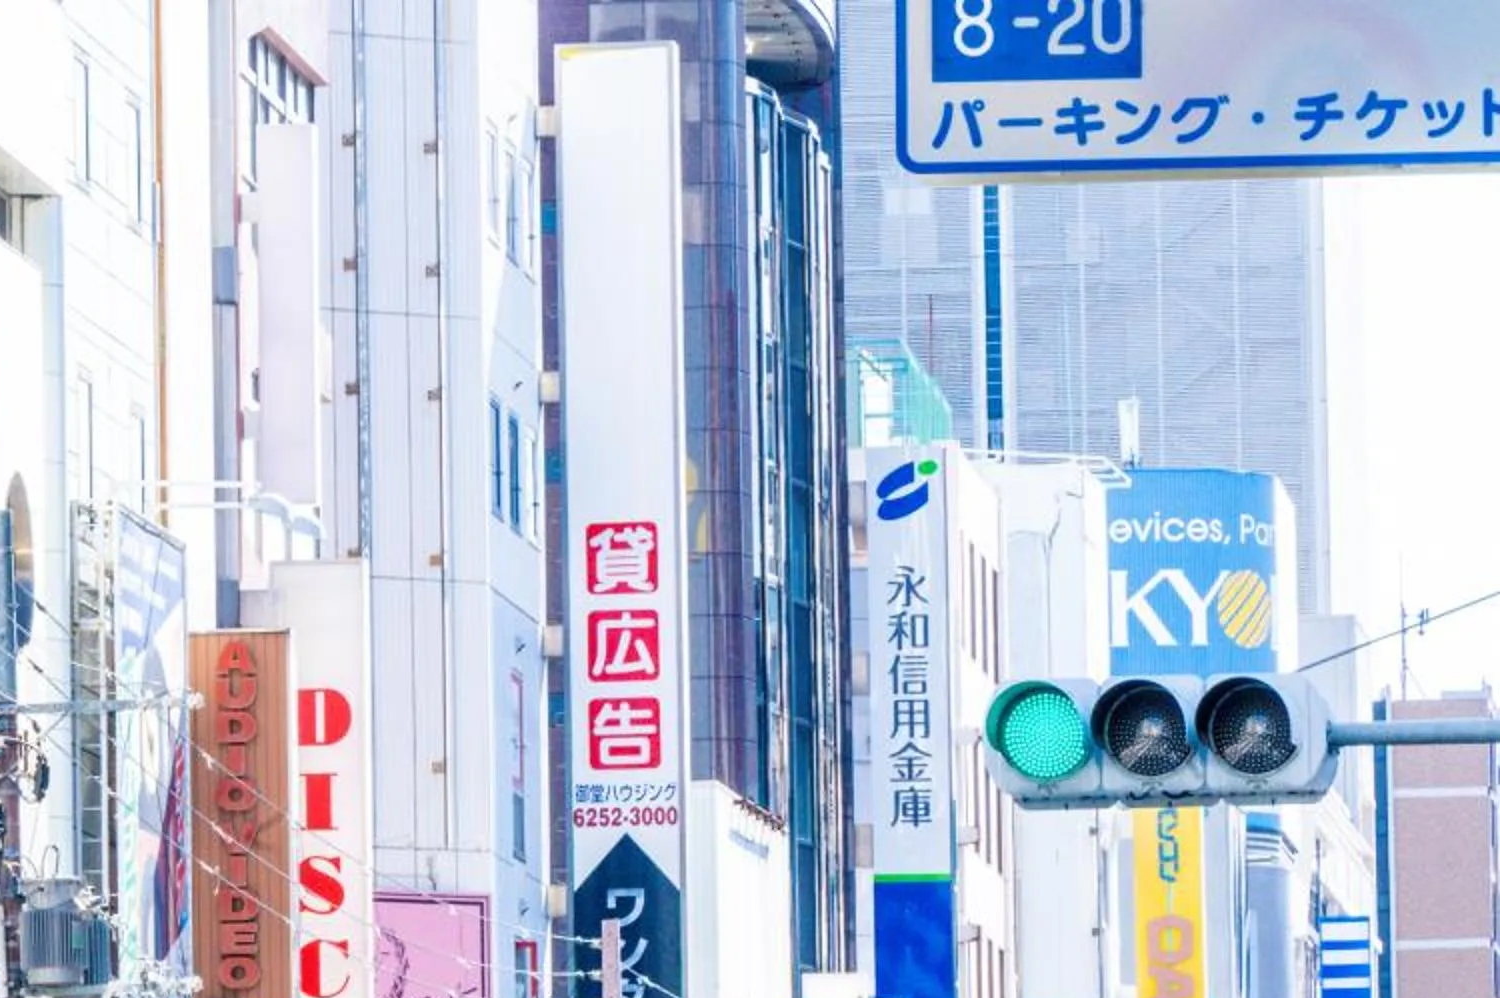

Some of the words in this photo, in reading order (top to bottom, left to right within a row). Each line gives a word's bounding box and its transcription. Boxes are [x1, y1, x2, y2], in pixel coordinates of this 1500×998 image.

[951, 0, 1133, 58] 8-20
[1110, 512, 1231, 545] evices,
[217, 640, 258, 812] AUDIO
[587, 523, 660, 769] 貸広告
[887, 565, 933, 828] 永和信用金庫
[219, 821, 260, 990] VIDEO
[296, 688, 352, 998] DISC
